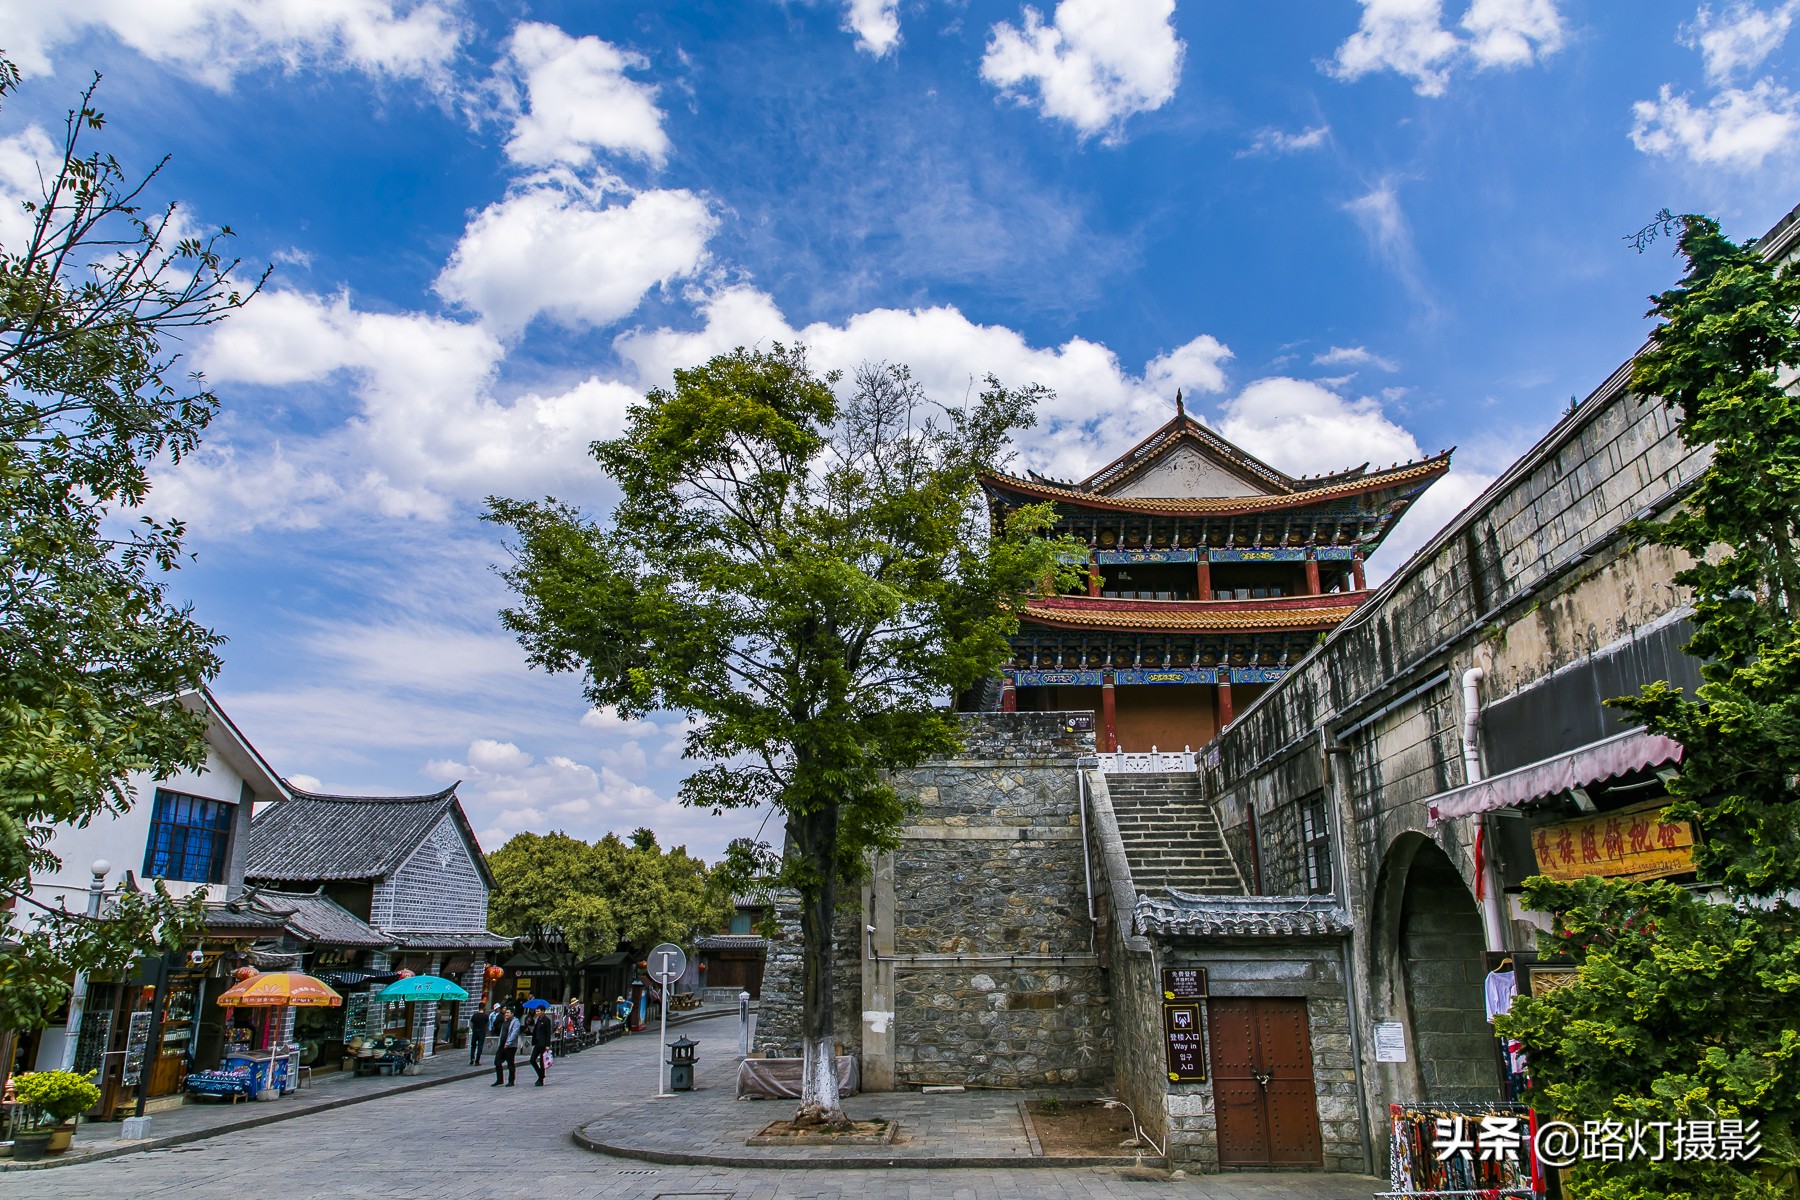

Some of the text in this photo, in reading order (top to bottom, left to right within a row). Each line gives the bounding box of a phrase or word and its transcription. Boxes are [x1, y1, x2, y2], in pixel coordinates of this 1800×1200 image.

[1170, 1033, 1199, 1041] 登楼入口
[1173, 1043, 1188, 1051] Way
[1179, 1053, 1193, 1061] 입구
